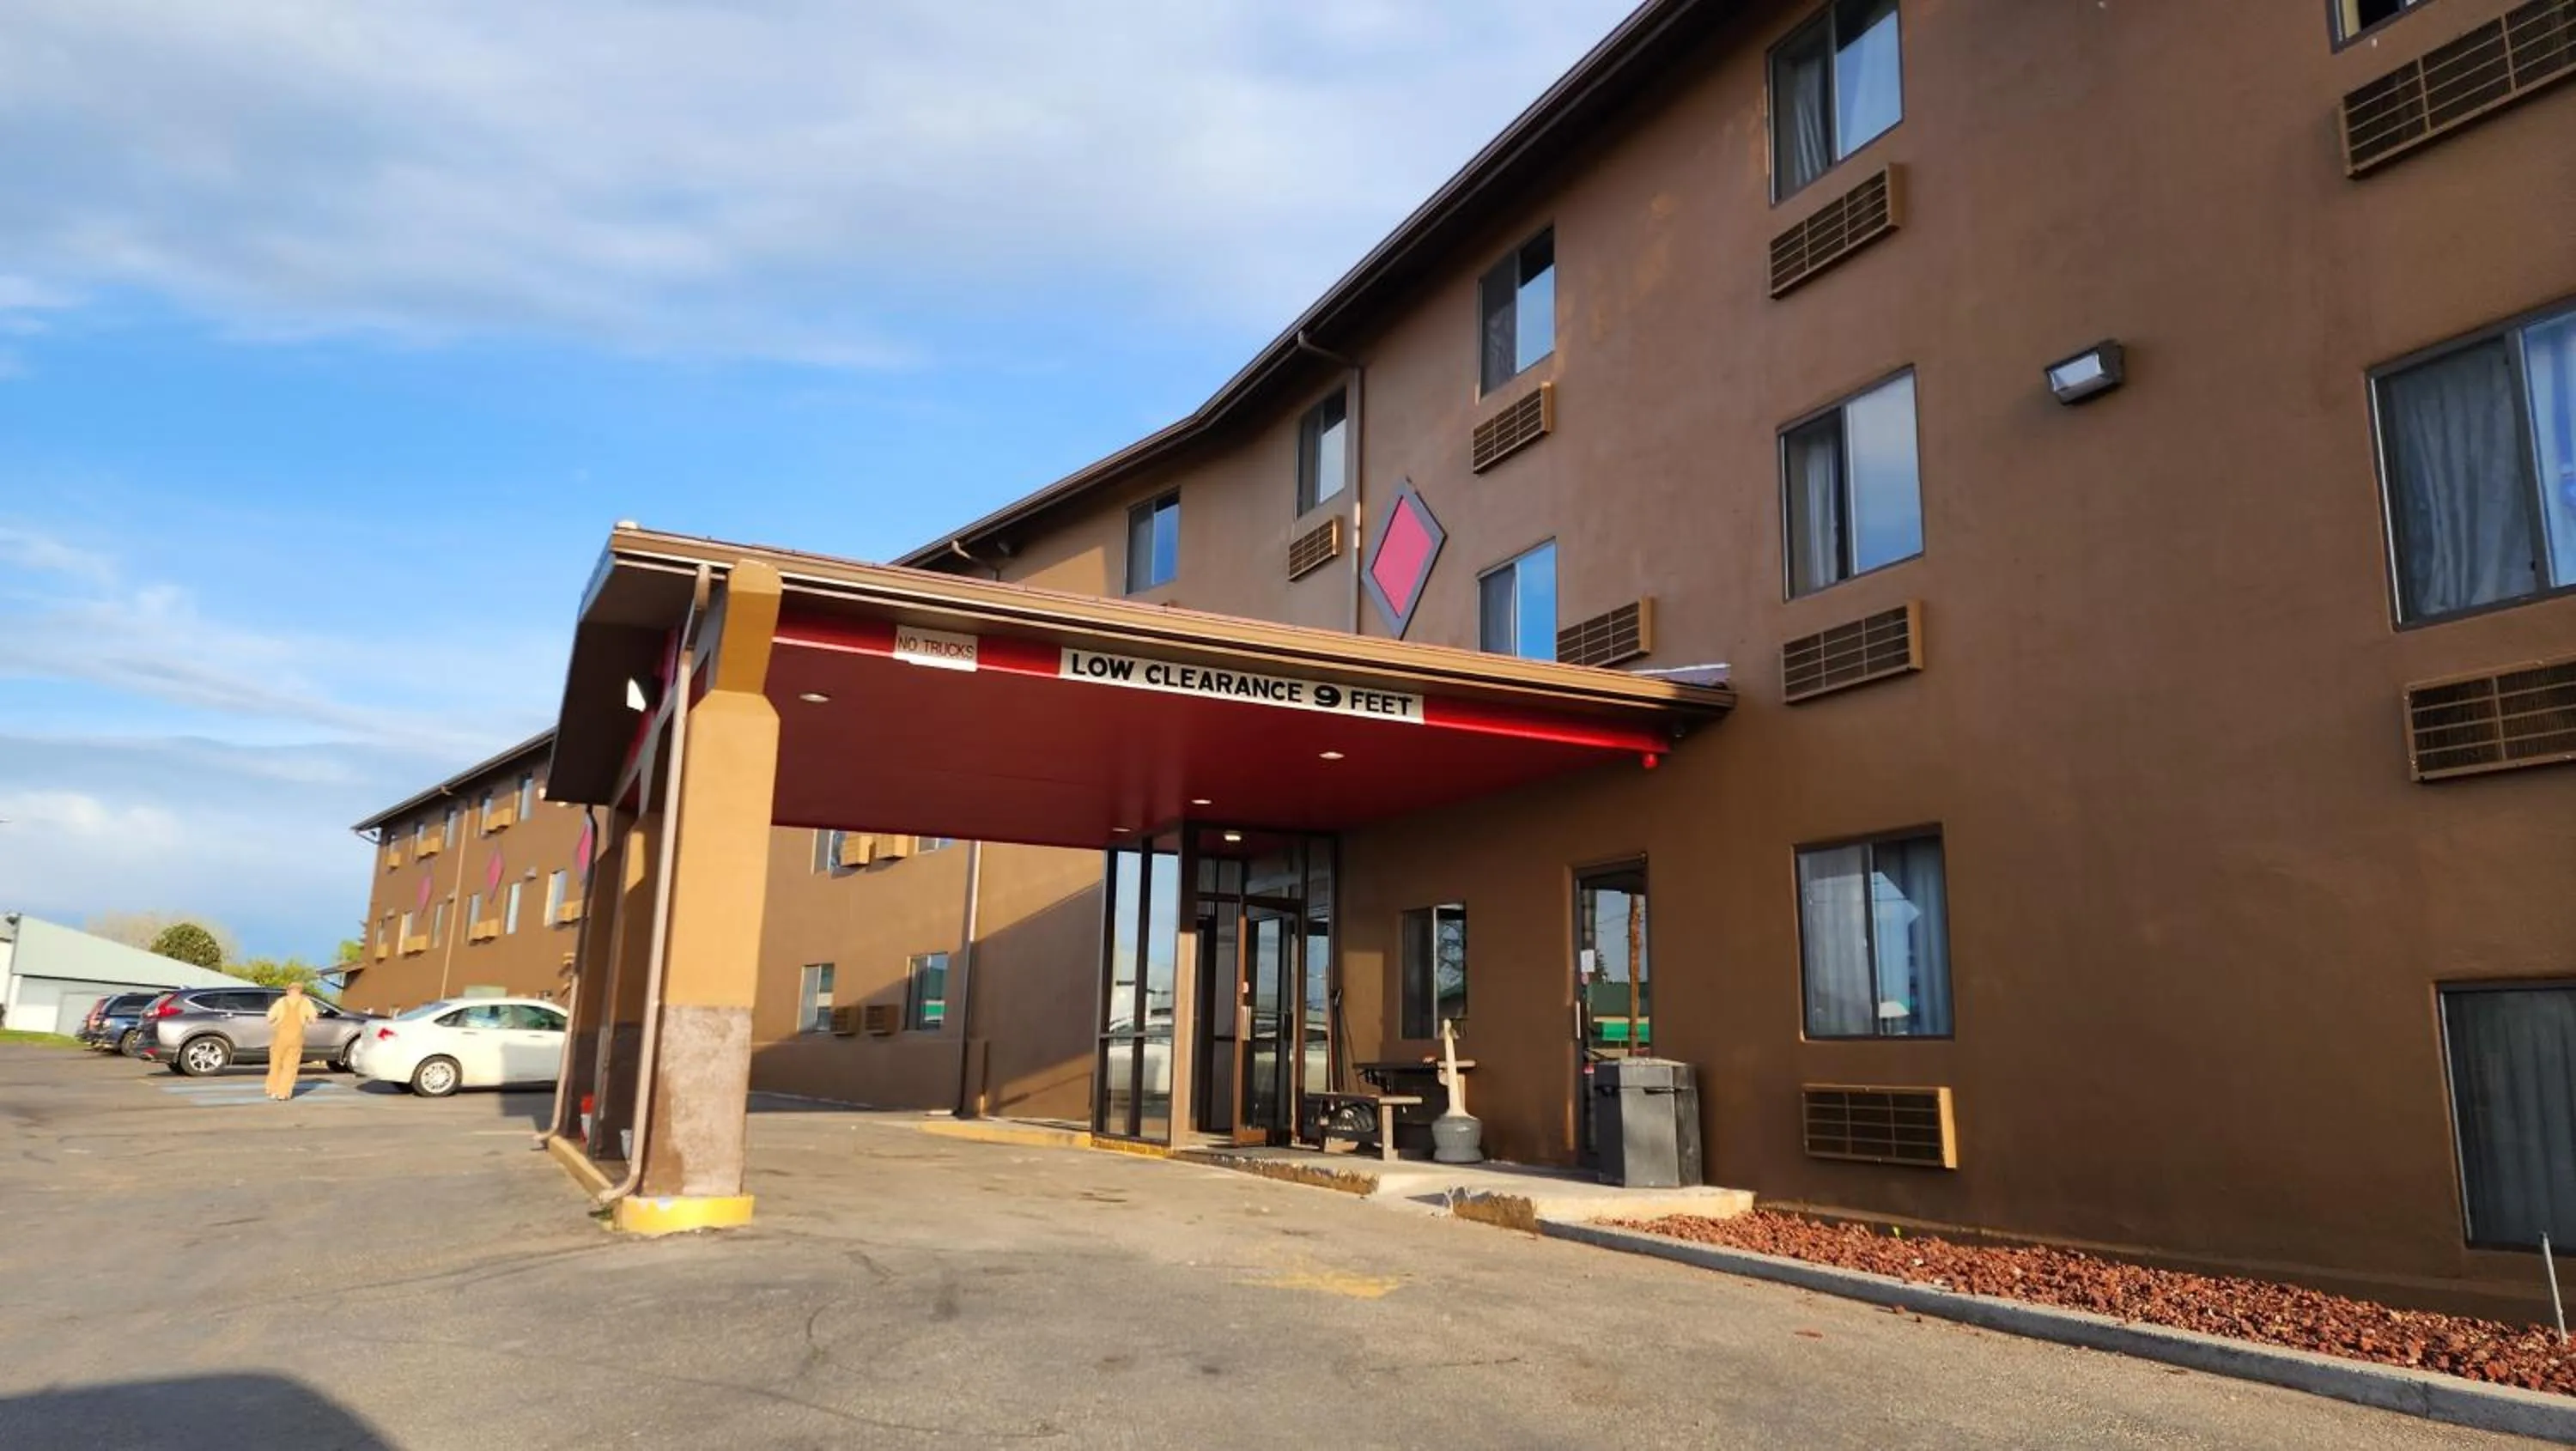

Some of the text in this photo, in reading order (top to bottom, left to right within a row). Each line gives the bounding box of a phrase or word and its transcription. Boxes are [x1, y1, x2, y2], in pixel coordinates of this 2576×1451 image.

[898, 634, 975, 659] NO TRUCKS
[1072, 653, 1413, 716] LOW CLEARANCE 9 FEET
